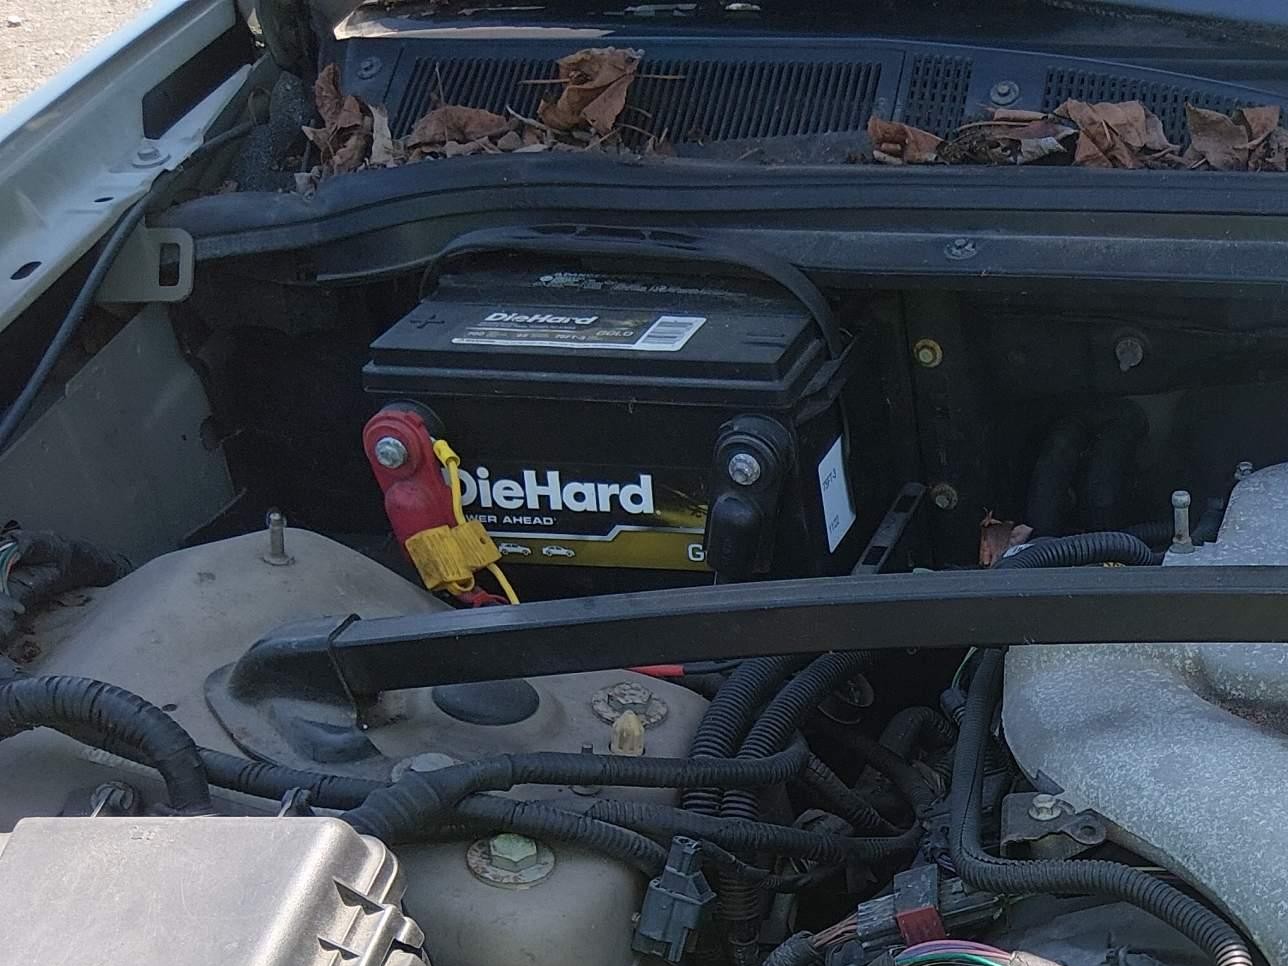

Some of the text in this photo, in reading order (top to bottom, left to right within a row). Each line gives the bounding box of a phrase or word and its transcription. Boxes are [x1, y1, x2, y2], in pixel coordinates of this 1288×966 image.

[485, 312, 599, 326] DieHard
[443, 467, 655, 514] DieHard
[502, 515, 555, 526] AHEAD
